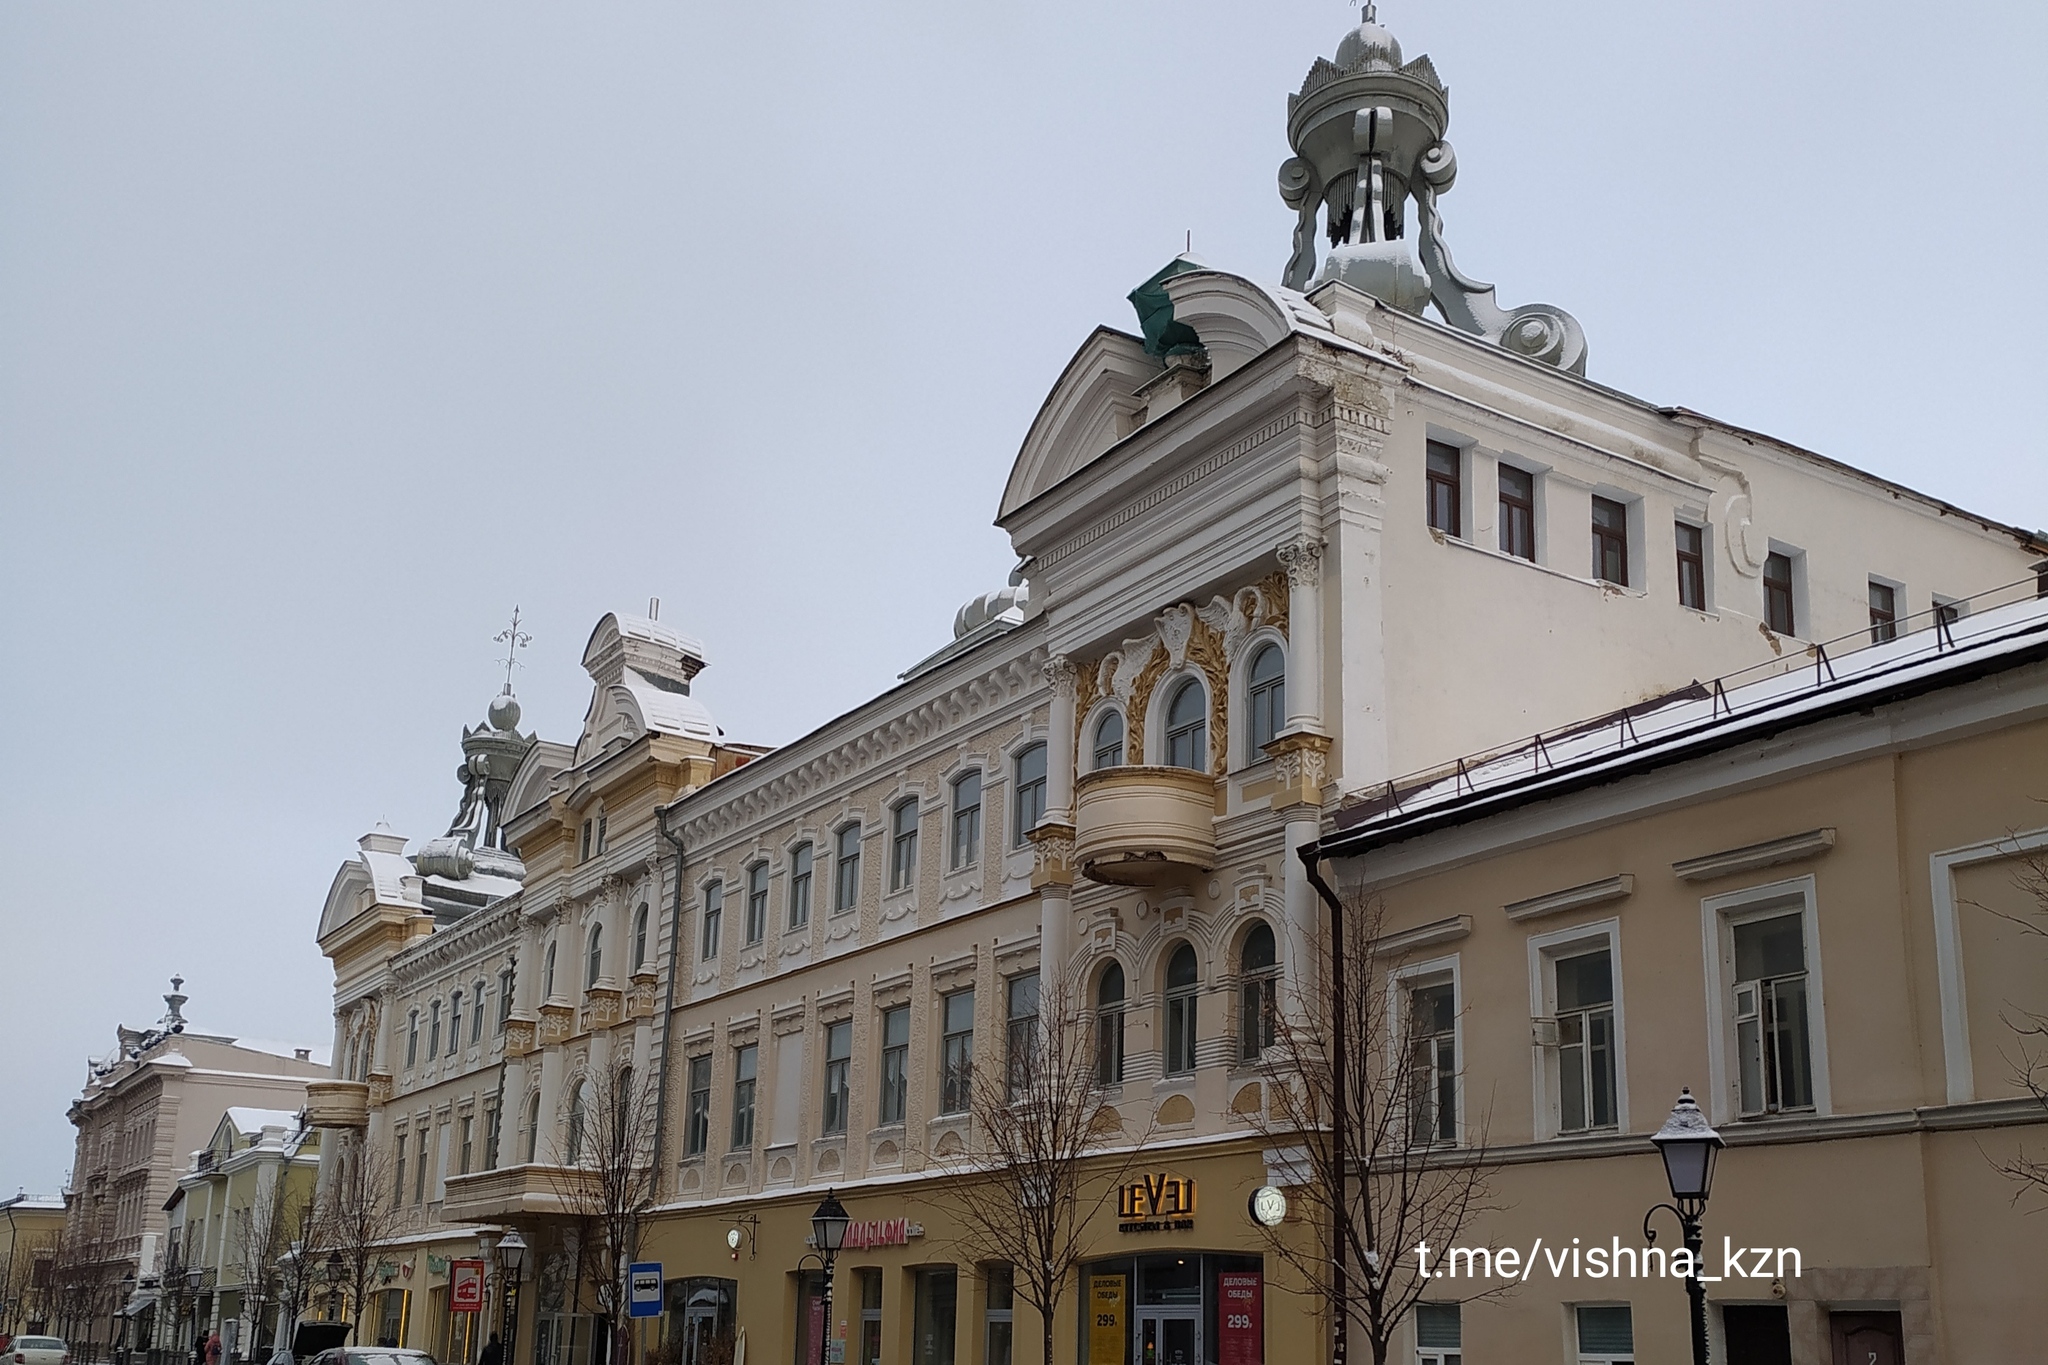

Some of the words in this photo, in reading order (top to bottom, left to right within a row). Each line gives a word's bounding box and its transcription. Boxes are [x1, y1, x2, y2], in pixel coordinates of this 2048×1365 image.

[1118, 1173, 1195, 1217] LEVEL
[1093, 1279, 1122, 1289] ДЕЛОВЫЕ
[1223, 1277, 1258, 1287] ДЕЛОВЫЕ
[1227, 1289, 1253, 1299] ОБЕДЫ
